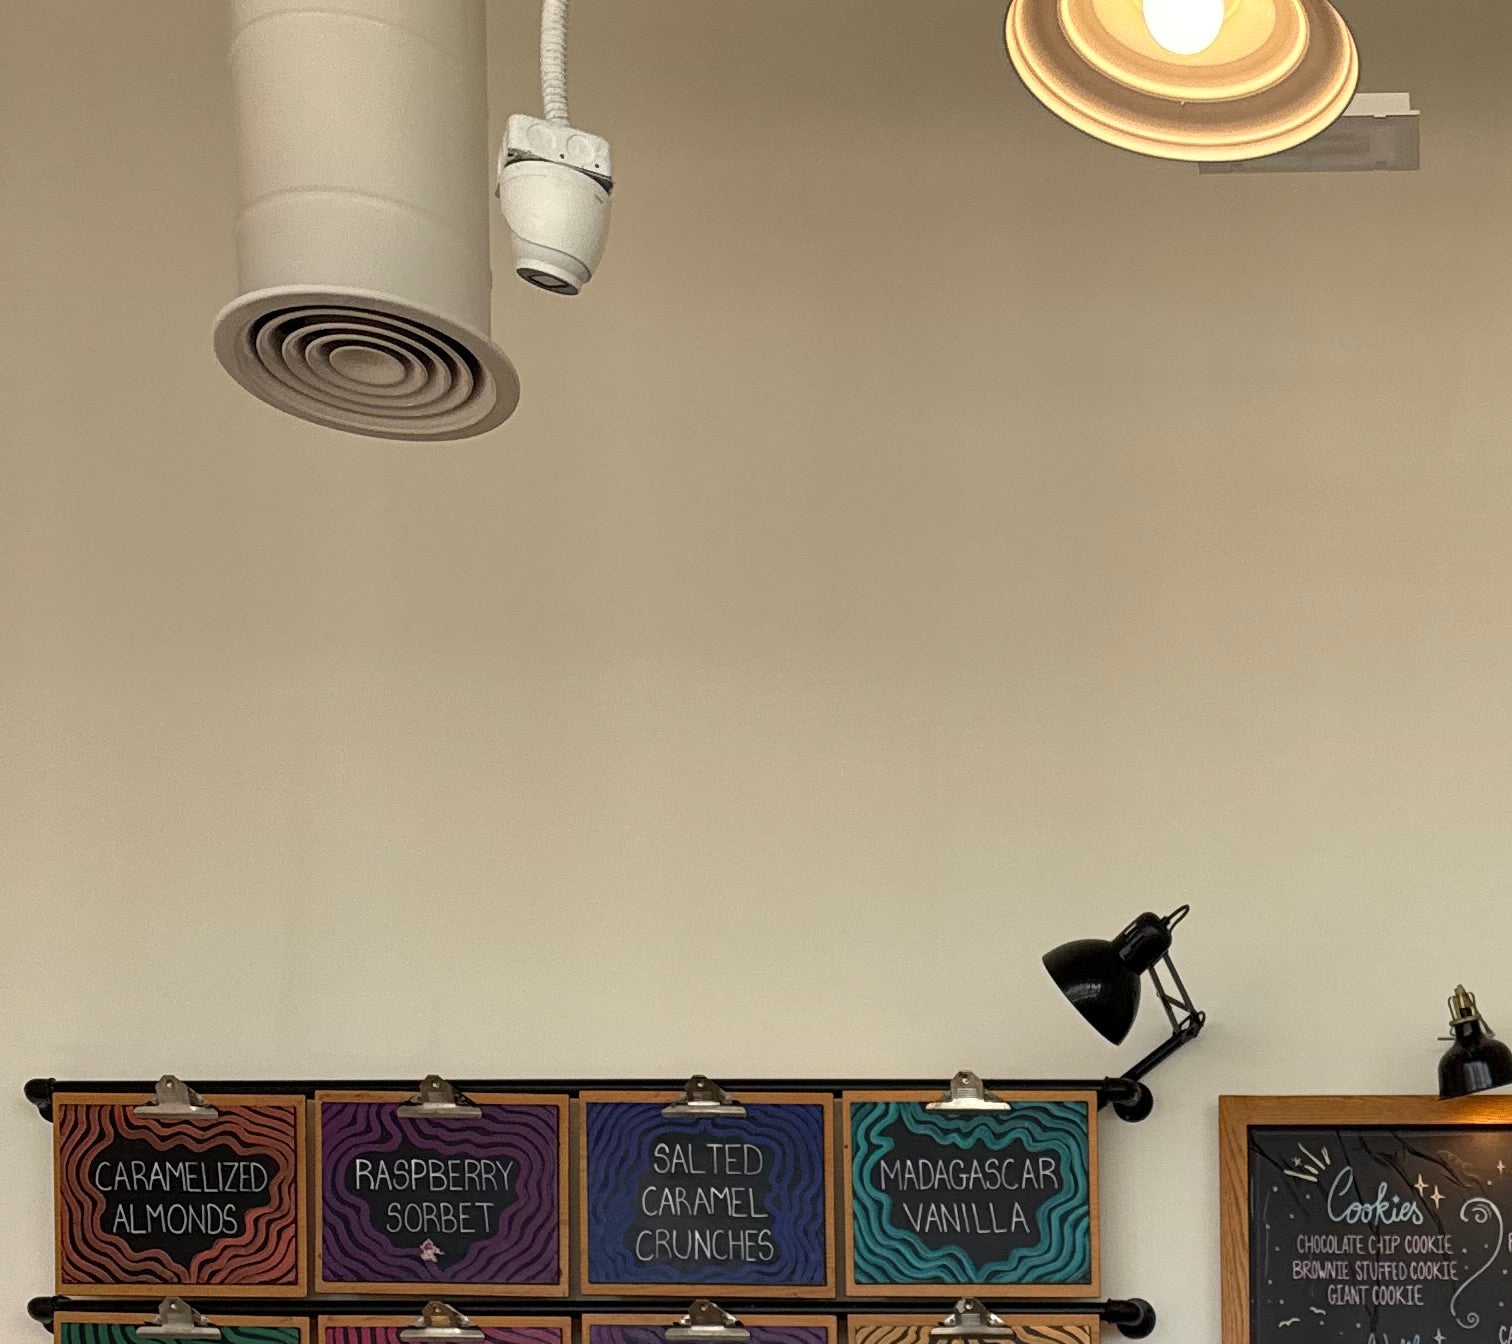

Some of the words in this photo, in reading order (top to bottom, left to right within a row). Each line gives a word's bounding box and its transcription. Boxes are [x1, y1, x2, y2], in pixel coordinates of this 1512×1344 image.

[354, 1158, 514, 1193] RASPBERRY
[653, 1143, 764, 1176] SALTED
[879, 1156, 1060, 1192] MADAGASCAR
[95, 1160, 269, 1194] CARAMELIZED
[641, 1186, 769, 1219] CARAMEL
[1327, 1165, 1424, 1226] Cookies
[112, 1203, 239, 1236] ALMONDS
[385, 1201, 496, 1234] SORBET
[902, 1201, 1031, 1235] VANILLA
[635, 1228, 775, 1263] CRUNCHES
[1296, 1234, 1366, 1255] CHOCOLATE
[1367, 1234, 1401, 1255] CHIP
[1404, 1234, 1454, 1255] COOKIE
[1292, 1260, 1351, 1281] BROWNIE
[1355, 1260, 1408, 1281] STUFFED
[1409, 1260, 1459, 1281] COOKIE
[1327, 1284, 1371, 1306] GIANT
[1371, 1284, 1424, 1306] COOKIE
